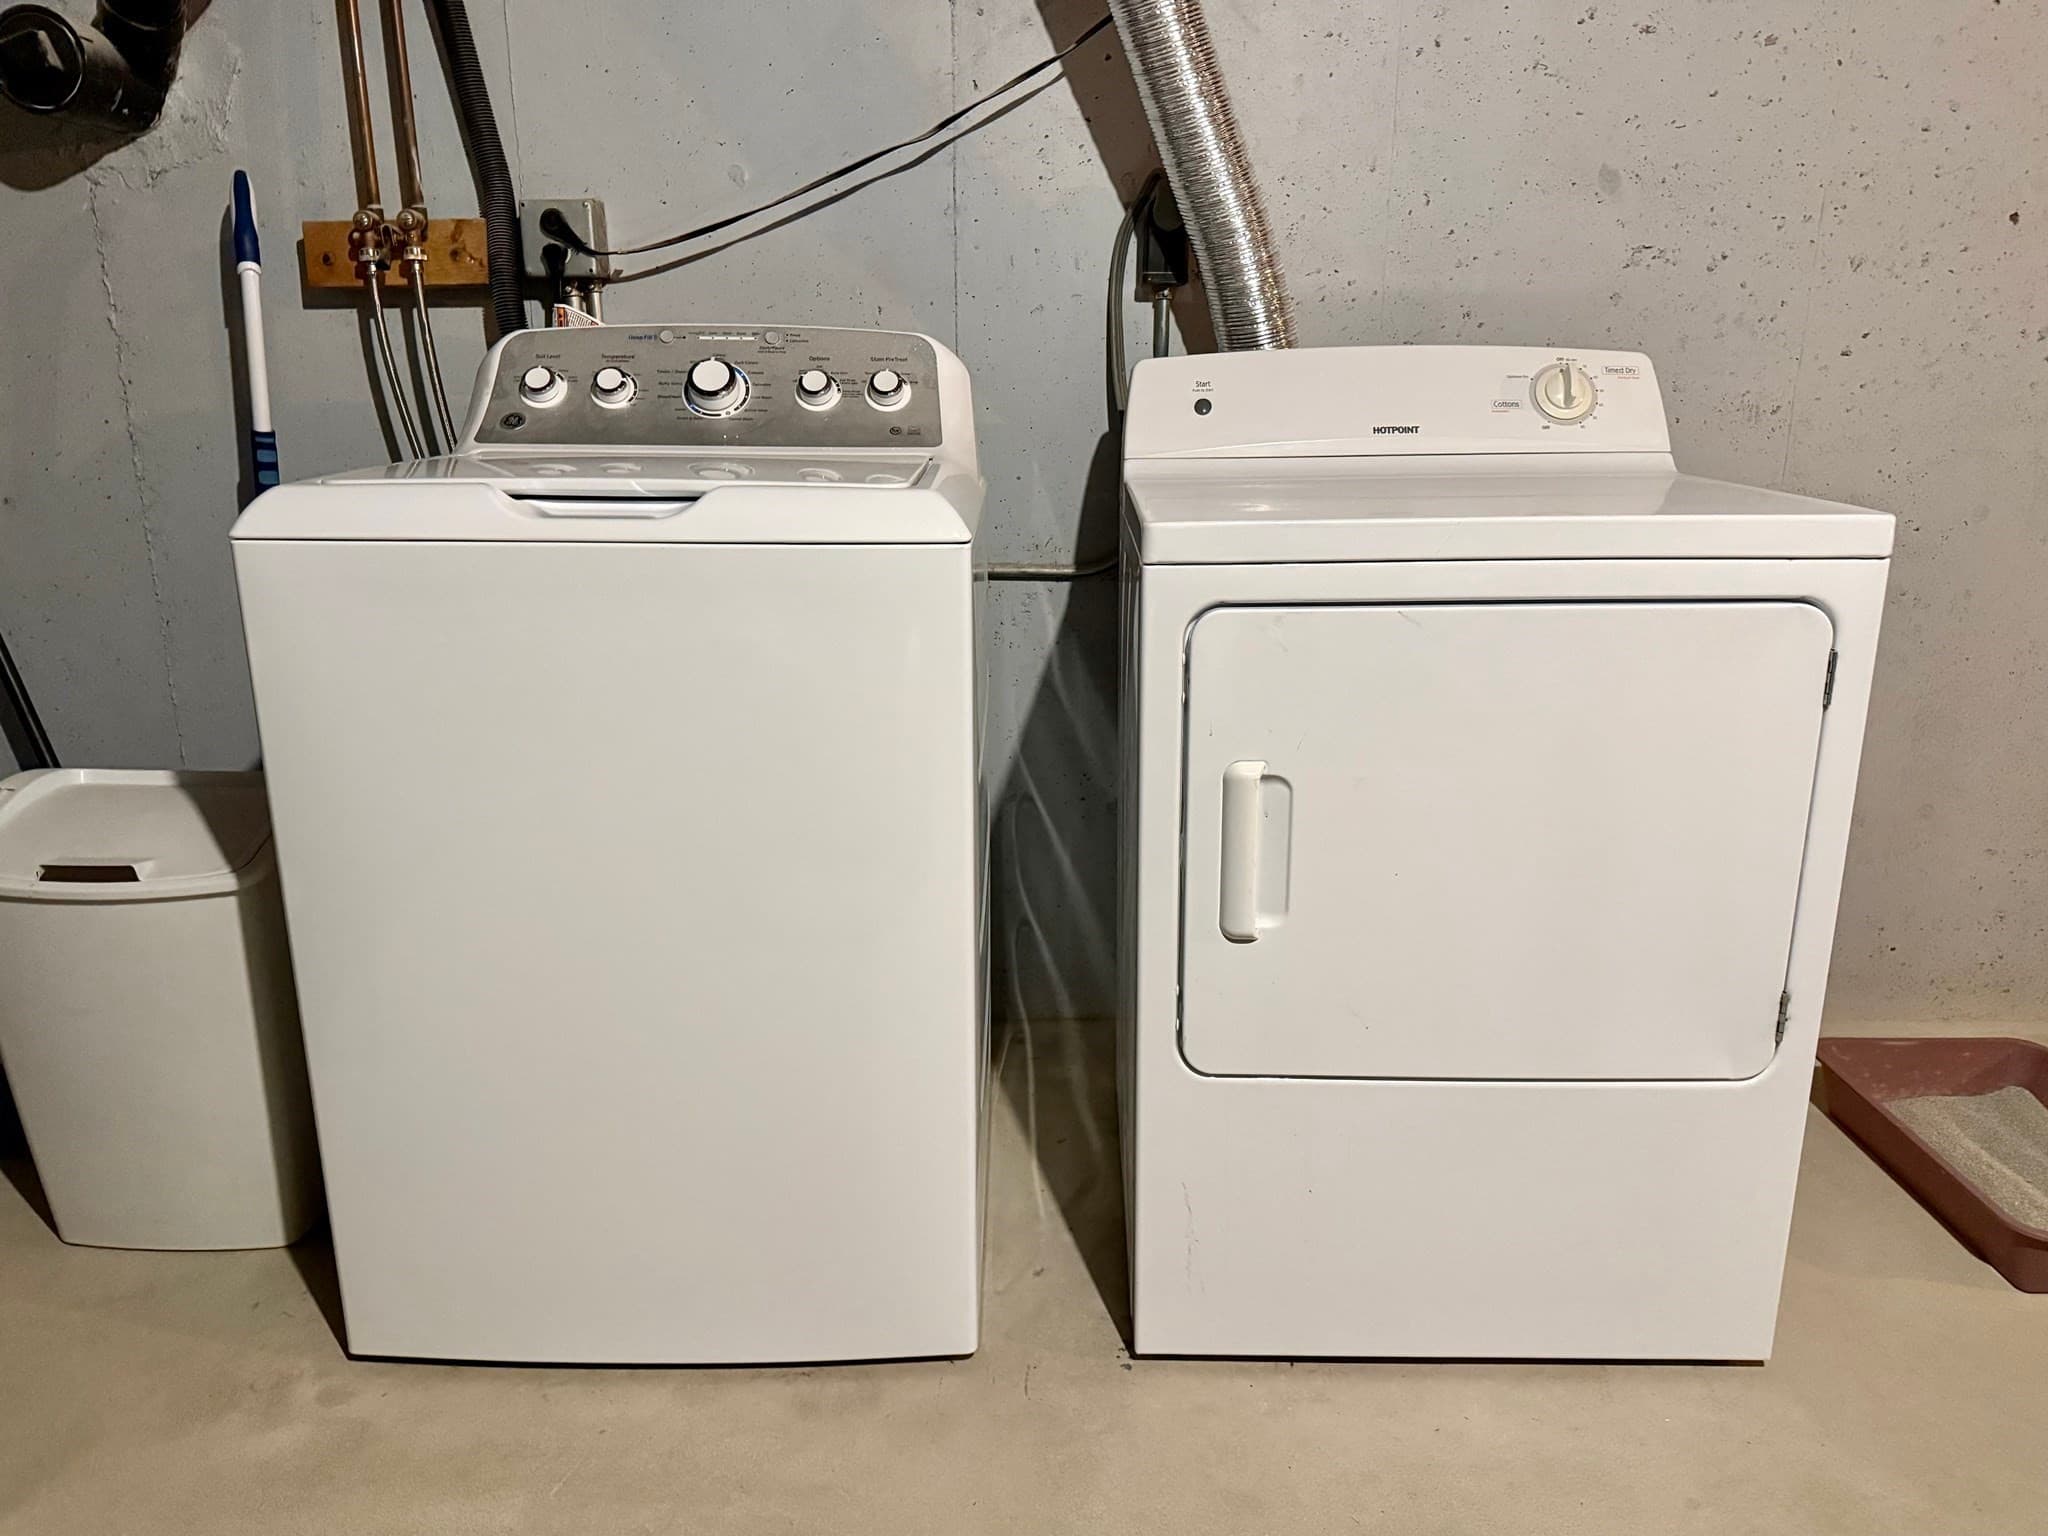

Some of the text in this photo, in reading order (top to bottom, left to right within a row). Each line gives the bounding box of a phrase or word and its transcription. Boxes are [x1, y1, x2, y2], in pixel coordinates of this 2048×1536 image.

[1605, 366, 1636, 375] Timed Dry
[1195, 380, 1212, 388] Start
[1493, 400, 1520, 408] Cottons
[1372, 425, 1420, 435] HOTPOINT
